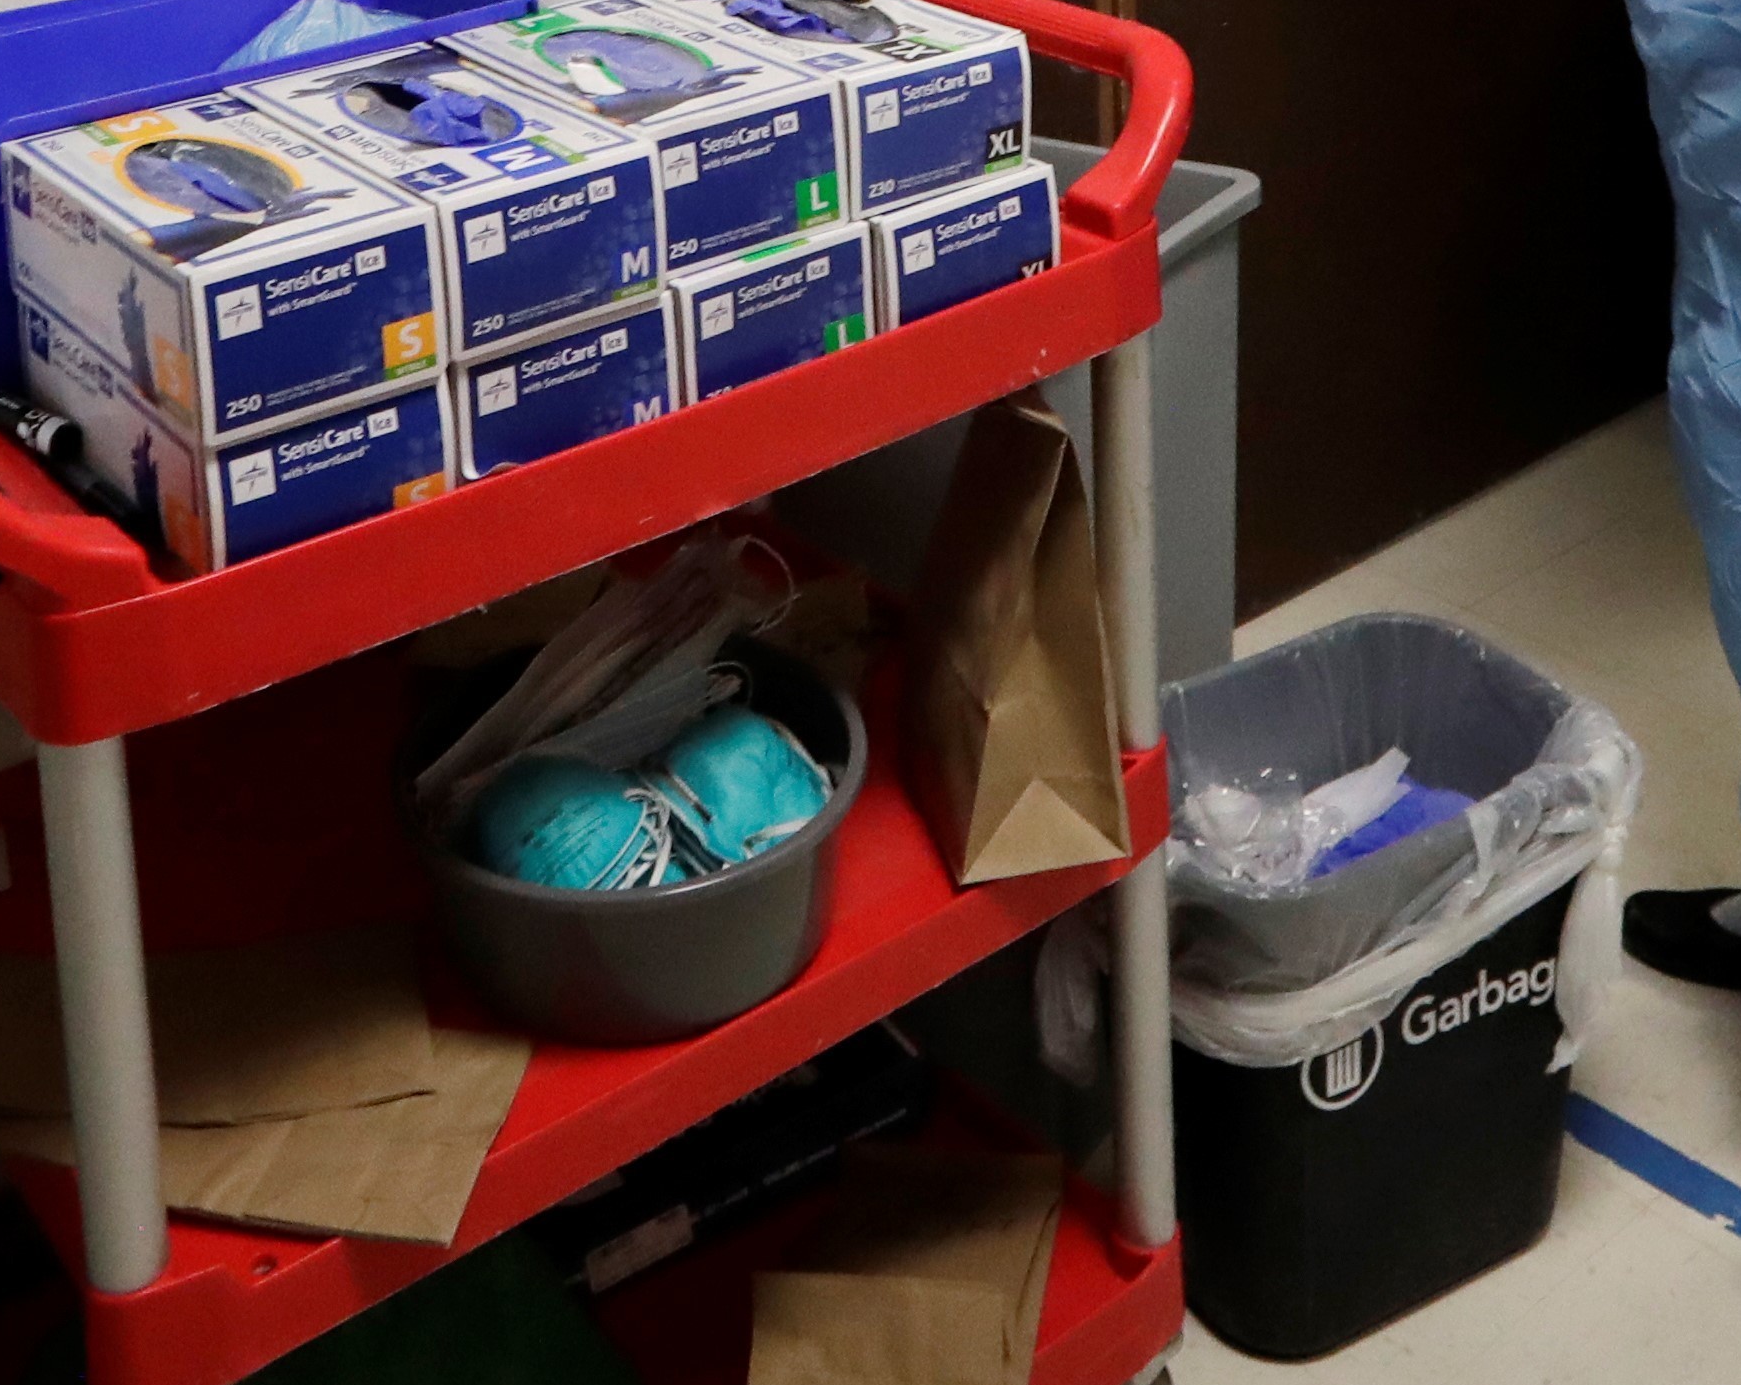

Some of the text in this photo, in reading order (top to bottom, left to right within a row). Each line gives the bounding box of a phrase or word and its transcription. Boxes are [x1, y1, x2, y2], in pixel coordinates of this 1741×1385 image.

[902, 72, 967, 102] SensiCare
[108, 116, 162, 133] S
[699, 122, 772, 156] SensiCare
[486, 145, 554, 172] M
[988, 129, 1021, 159] XL
[507, 190, 585, 226] SensiCare
[809, 181, 830, 211] L
[935, 208, 997, 242] SensiCare
[620, 246, 650, 283] M
[668, 237, 699, 260] 250
[264, 252, 381, 300] SensiCare Ice
[736, 269, 804, 305] SensiCare
[267, 303, 290, 318] with
[471, 313, 505, 338] 250
[399, 321, 424, 359] S
[520, 342, 598, 380] SensiCare
[225, 393, 263, 420] 250
[633, 396, 662, 425] M
[277, 424, 365, 464] SensiCare
[1400, 956, 1559, 1047] Garbag
